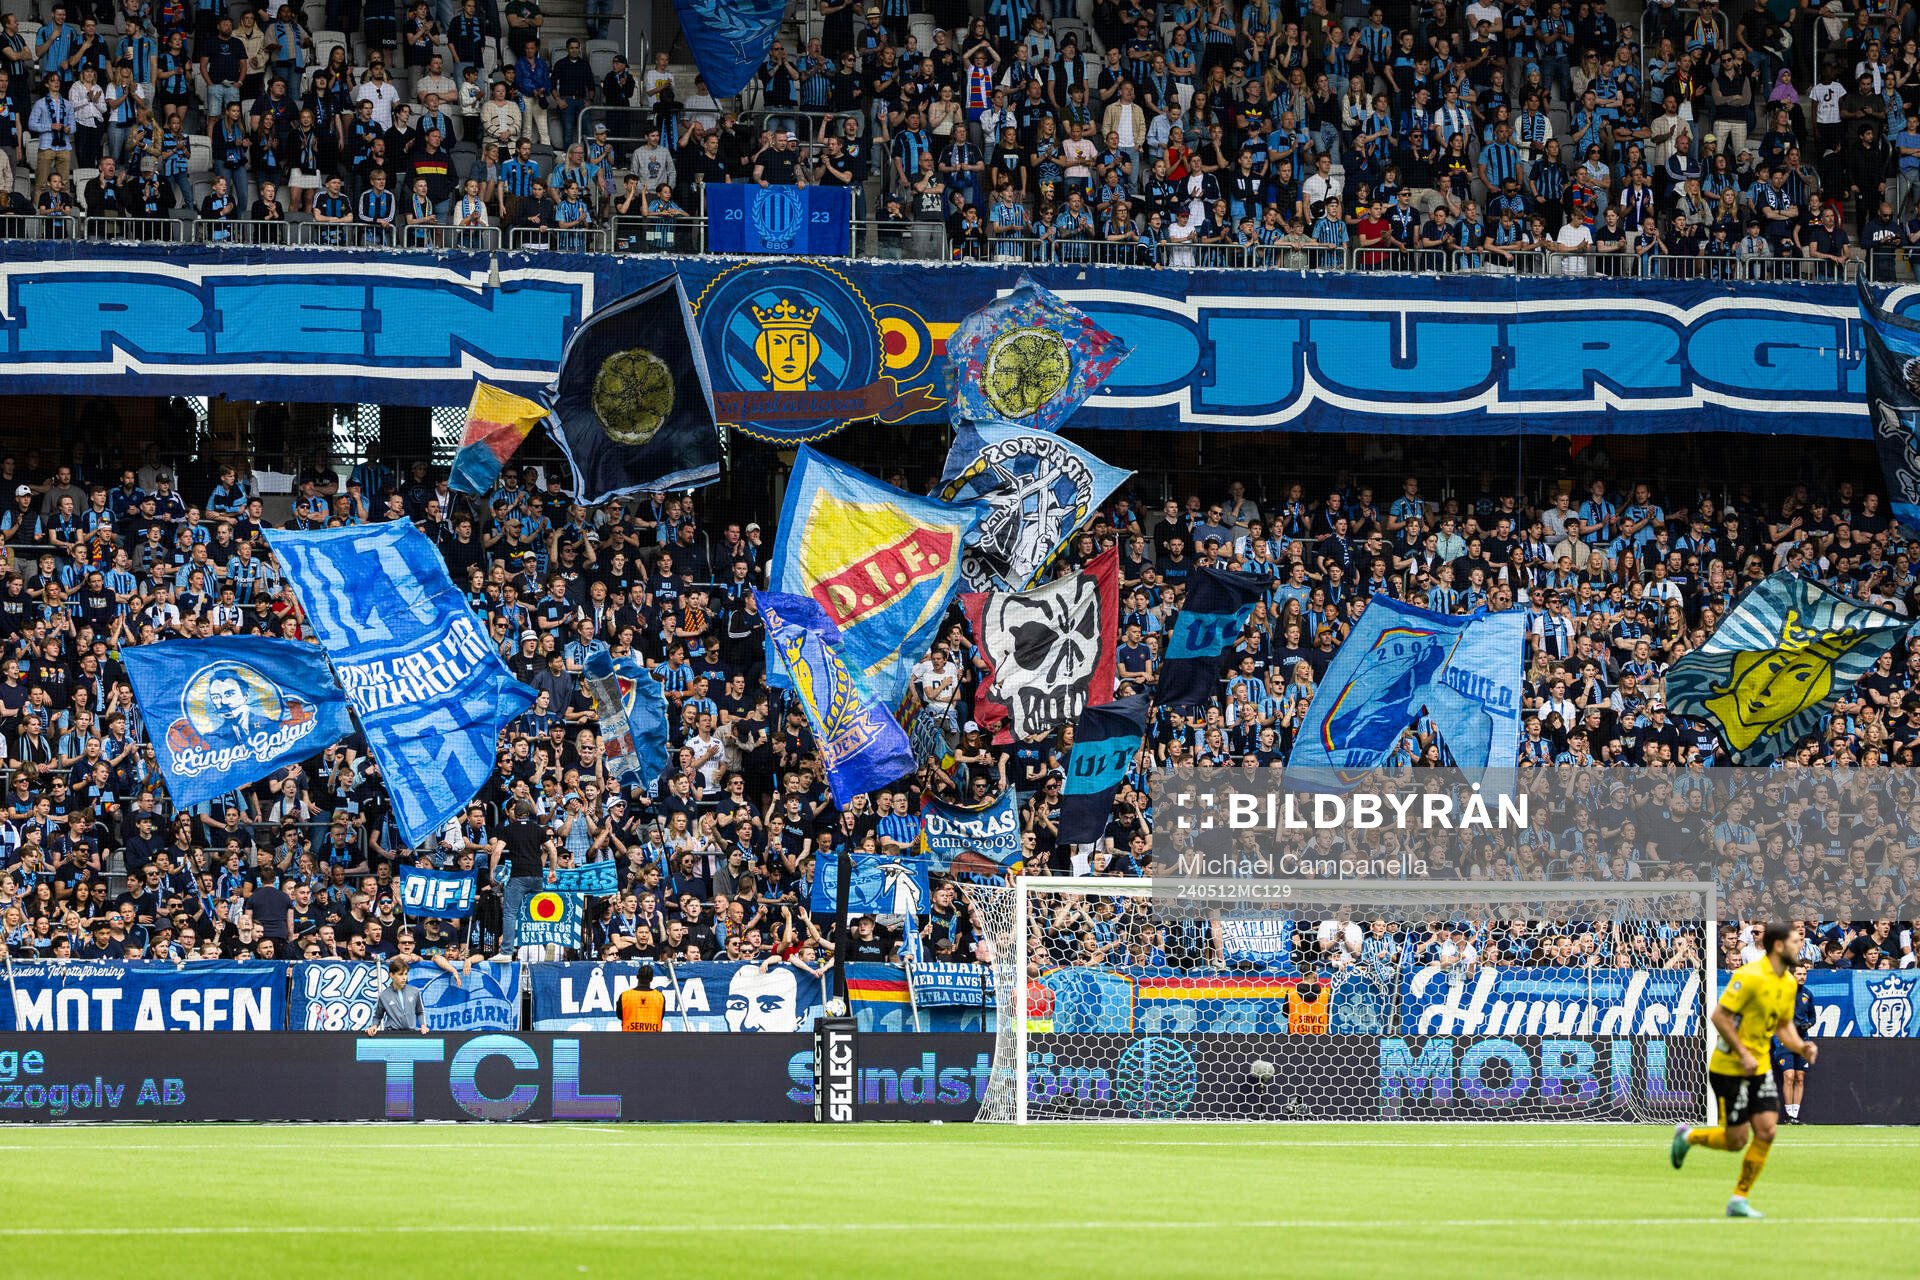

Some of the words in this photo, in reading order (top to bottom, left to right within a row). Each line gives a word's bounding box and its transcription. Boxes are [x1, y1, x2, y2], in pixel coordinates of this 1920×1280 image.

[724, 207, 743, 220] 20
[811, 211, 830, 224] 23
[766, 240, 789, 250] BBG
[0, 266, 588, 374] REN
[827, 541, 940, 619] D.I.F.
[174, 743, 249, 775] Långa
[249, 719, 317, 758] Gatan
[925, 810, 1017, 840] ULTRAS
[932, 835, 972, 849] anno
[973, 834, 1016, 850] 2003
[404, 873, 474, 909] DIF!
[521, 931, 572, 945] ULTRAS
[937, 976, 953, 987] DE
[953, 990, 982, 1003] CAOS
[15, 987, 123, 1032] MOT
[305, 1001, 380, 1032] 189
[427, 1001, 509, 1031] JURGÅRN
[356, 1034, 622, 1119] TCL
[830, 1031, 852, 1121] SELECT
[1379, 1037, 1695, 1112] MOBIL
[135, 1078, 186, 1106] AB
